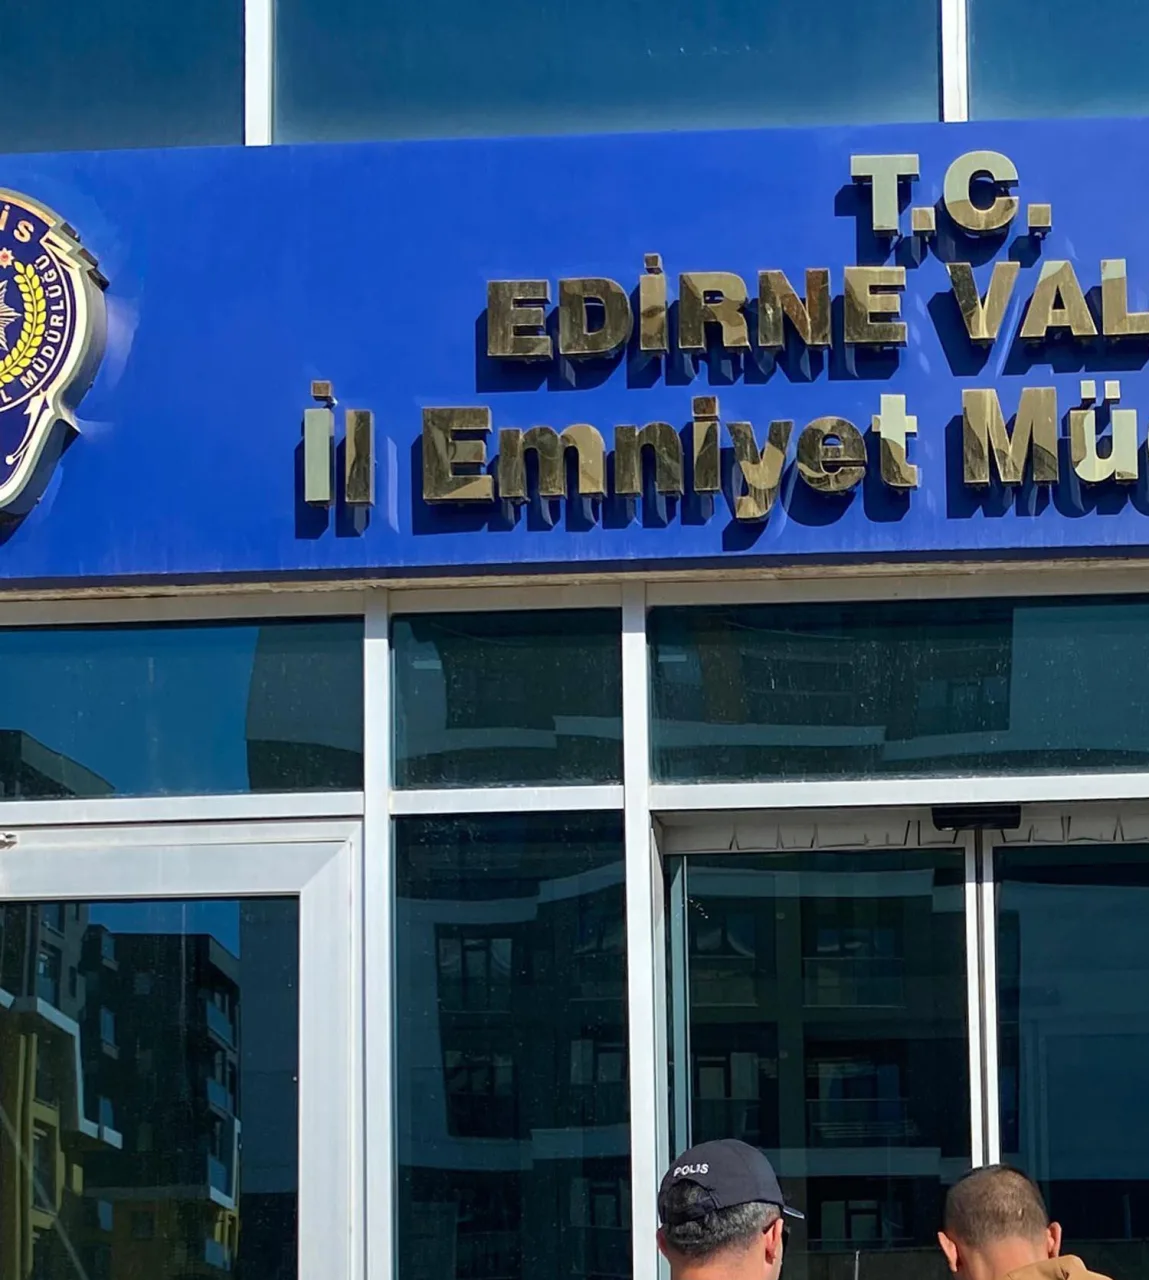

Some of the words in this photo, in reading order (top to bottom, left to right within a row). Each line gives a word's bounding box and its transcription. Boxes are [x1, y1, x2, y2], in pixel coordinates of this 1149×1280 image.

[850, 150, 1053, 239] T.C.
[20, 255, 65, 388] MÜDÜRLÜĞÜ
[486, 252, 908, 361] EDİRNE
[304, 380, 375, 506] İl
[421, 394, 922, 523] Emniyet
